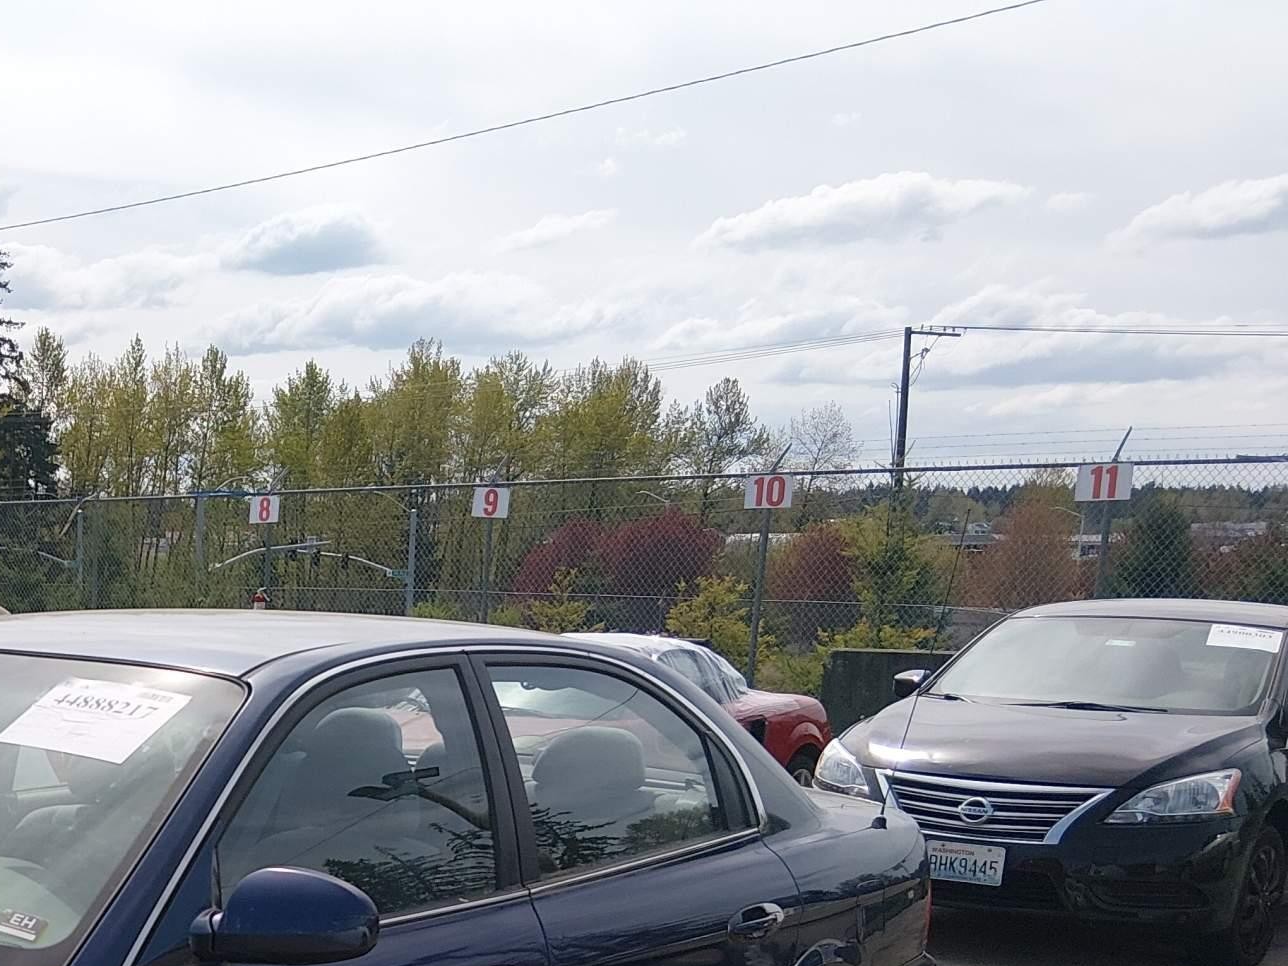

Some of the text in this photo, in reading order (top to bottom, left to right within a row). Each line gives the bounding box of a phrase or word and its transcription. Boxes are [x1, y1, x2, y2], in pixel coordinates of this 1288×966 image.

[753, 475, 786, 507] 10
[1090, 465, 1119, 499] 11
[258, 497, 271, 522] 8
[483, 488, 499, 516] 9
[53, 693, 159, 719] 44888217
[960, 806, 989, 815] NISSAN
[932, 846, 975, 856] WASHINGTON
